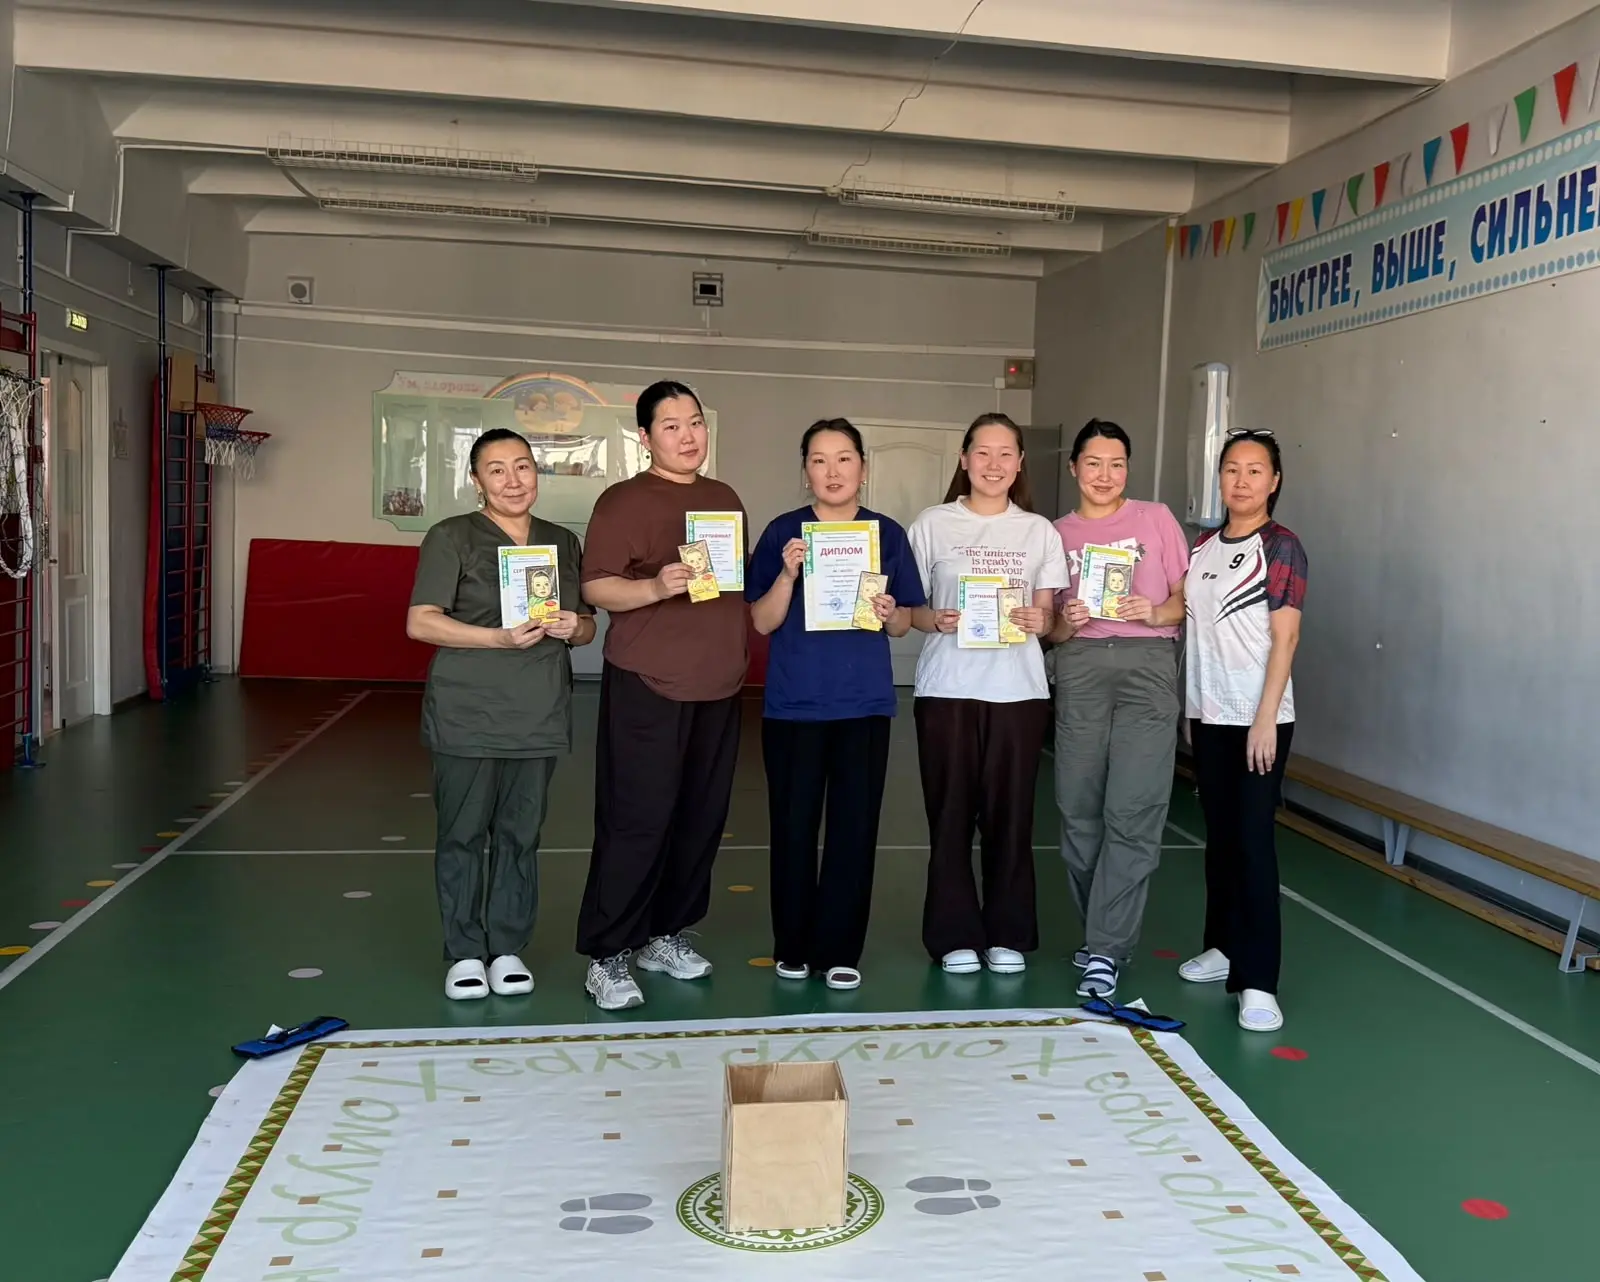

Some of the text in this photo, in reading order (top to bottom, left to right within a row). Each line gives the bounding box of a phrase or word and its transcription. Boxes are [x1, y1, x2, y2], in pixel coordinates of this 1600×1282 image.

[1268, 165, 1600, 324] БЫСТРЕЕ, ВЫШЕ, СИЛЬНЕ
[820, 547, 863, 557] ДИПЛОМ
[965, 548, 981, 557] the
[984, 549, 1027, 558] universe
[982, 557, 1010, 567] ready
[1012, 558, 1022, 566] to
[1228, 553, 1245, 569] 9
[971, 566, 1025, 576] make your
